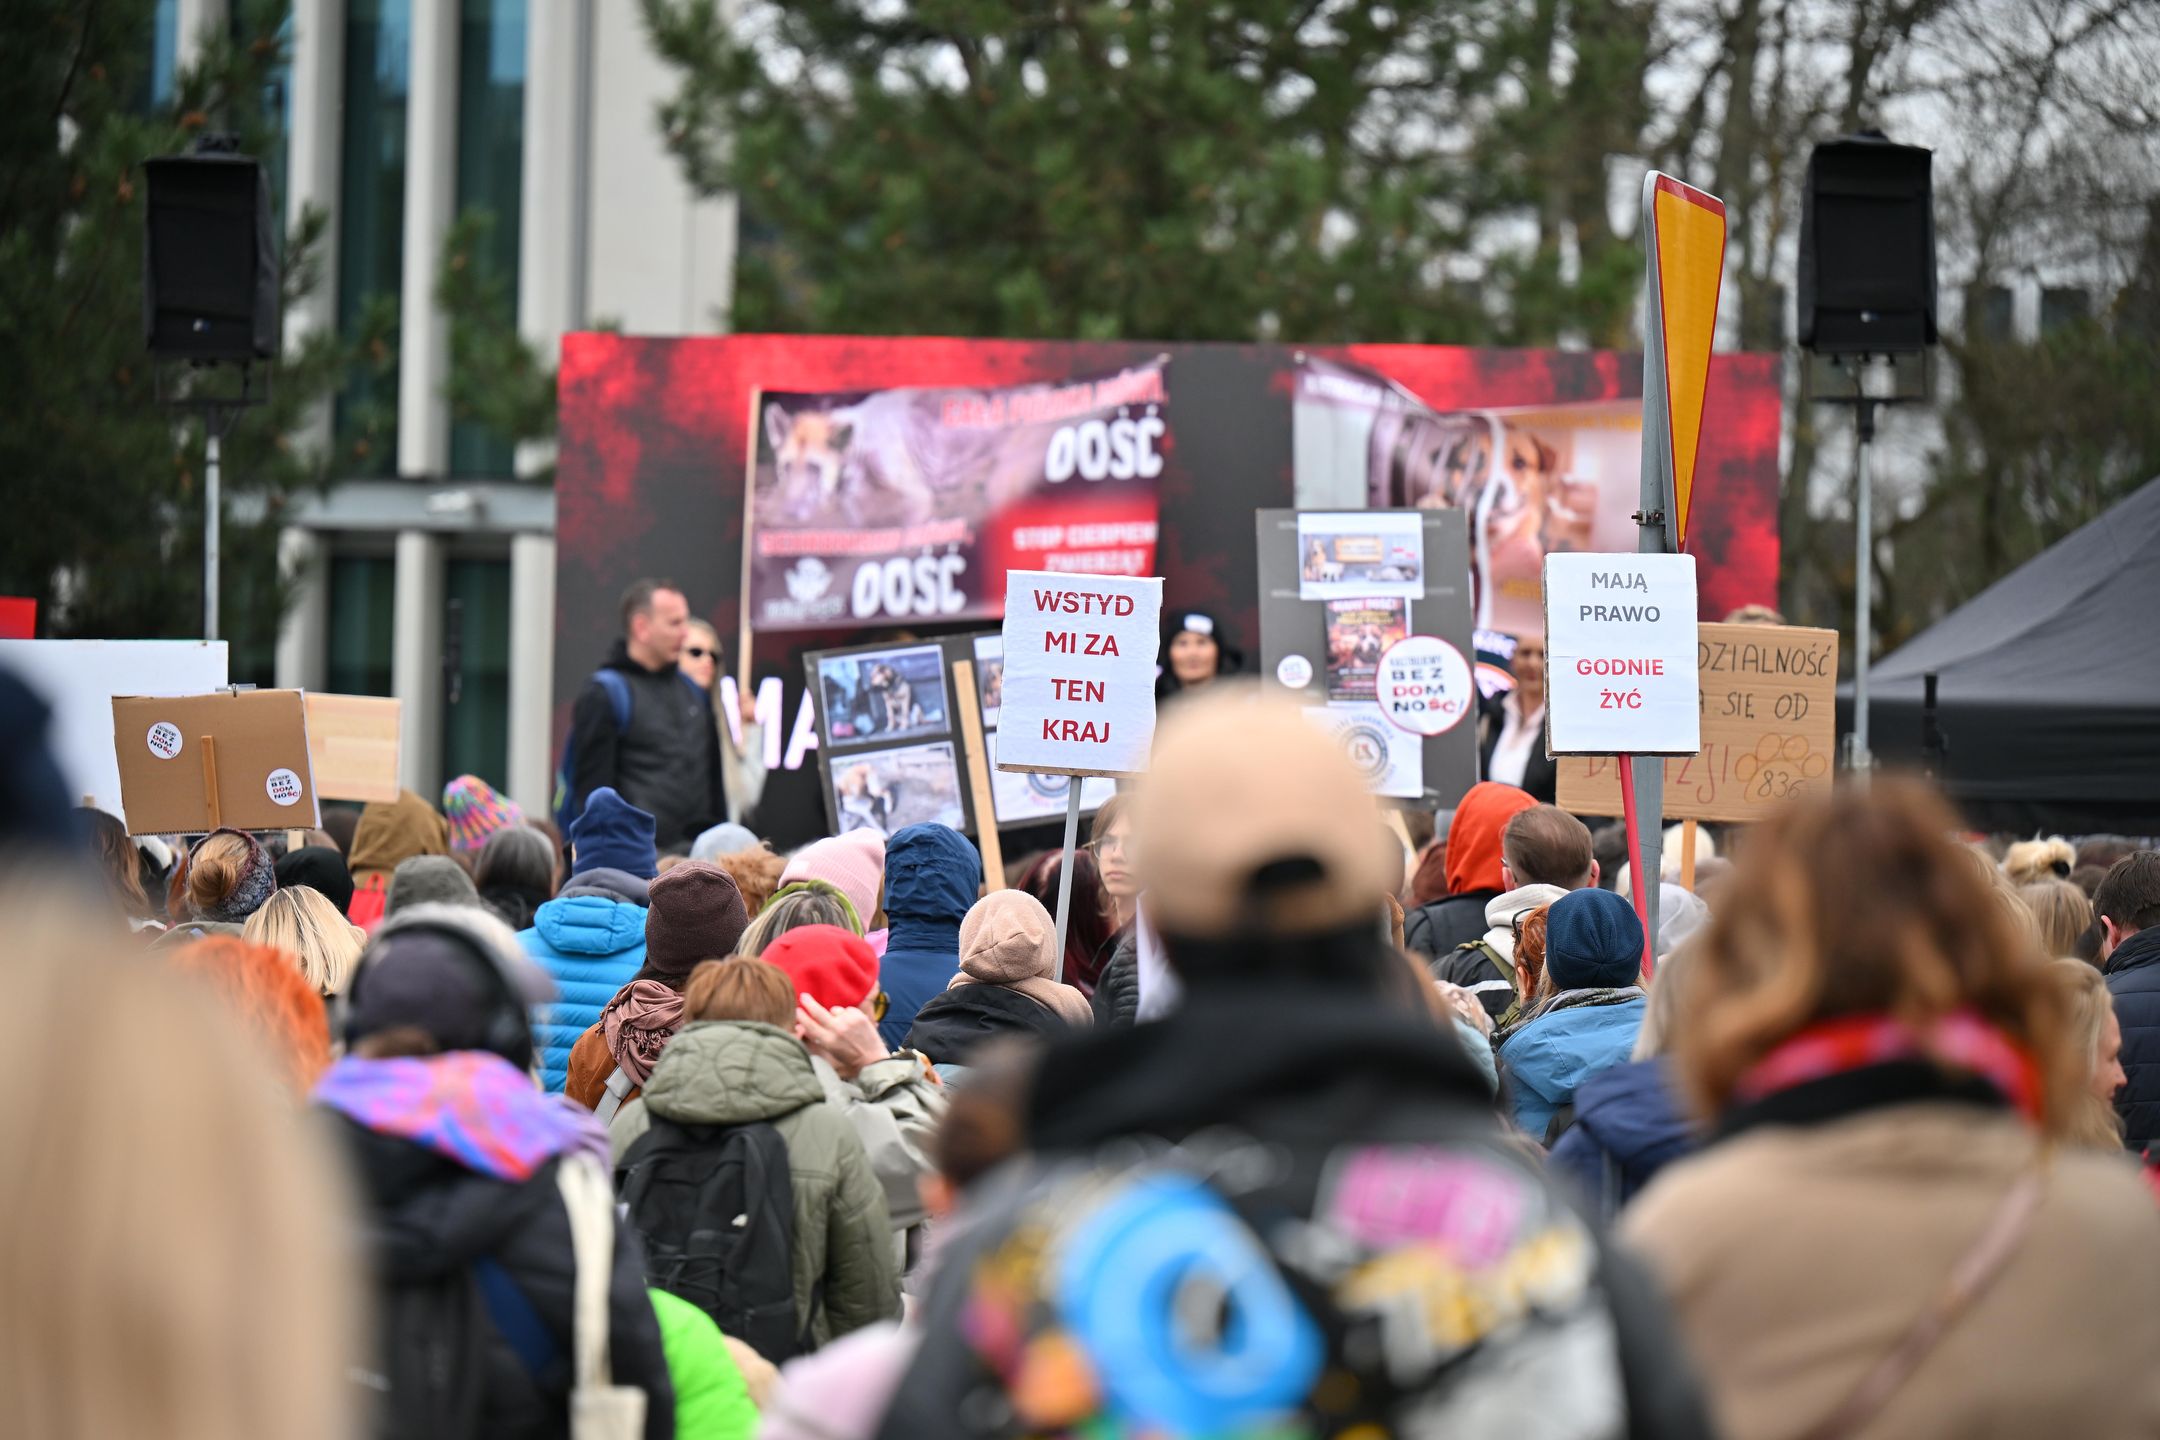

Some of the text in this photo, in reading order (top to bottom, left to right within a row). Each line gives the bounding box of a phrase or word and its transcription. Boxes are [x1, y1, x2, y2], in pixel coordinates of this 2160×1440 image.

[1590, 572, 1648, 593] MAJĄ
[1034, 589, 1135, 617] WSTYD
[1579, 605, 1661, 623] PRAWO
[1044, 631, 1120, 657] MI ZA
[1391, 668, 1443, 680] BEZ
[1576, 659, 1664, 676] GODNIE
[1051, 678, 1105, 703] TEN
[1393, 685, 1445, 698] DOM
[1600, 688, 1642, 709] ŻYĆ
[1722, 691, 1754, 718] SIĘ
[1775, 692, 1808, 720] OD
[155, 729, 174, 742] BEZ
[1042, 718, 1110, 744] KRAJ
[153, 735, 173, 747] DOM
[271, 779, 291, 787] BEZ
